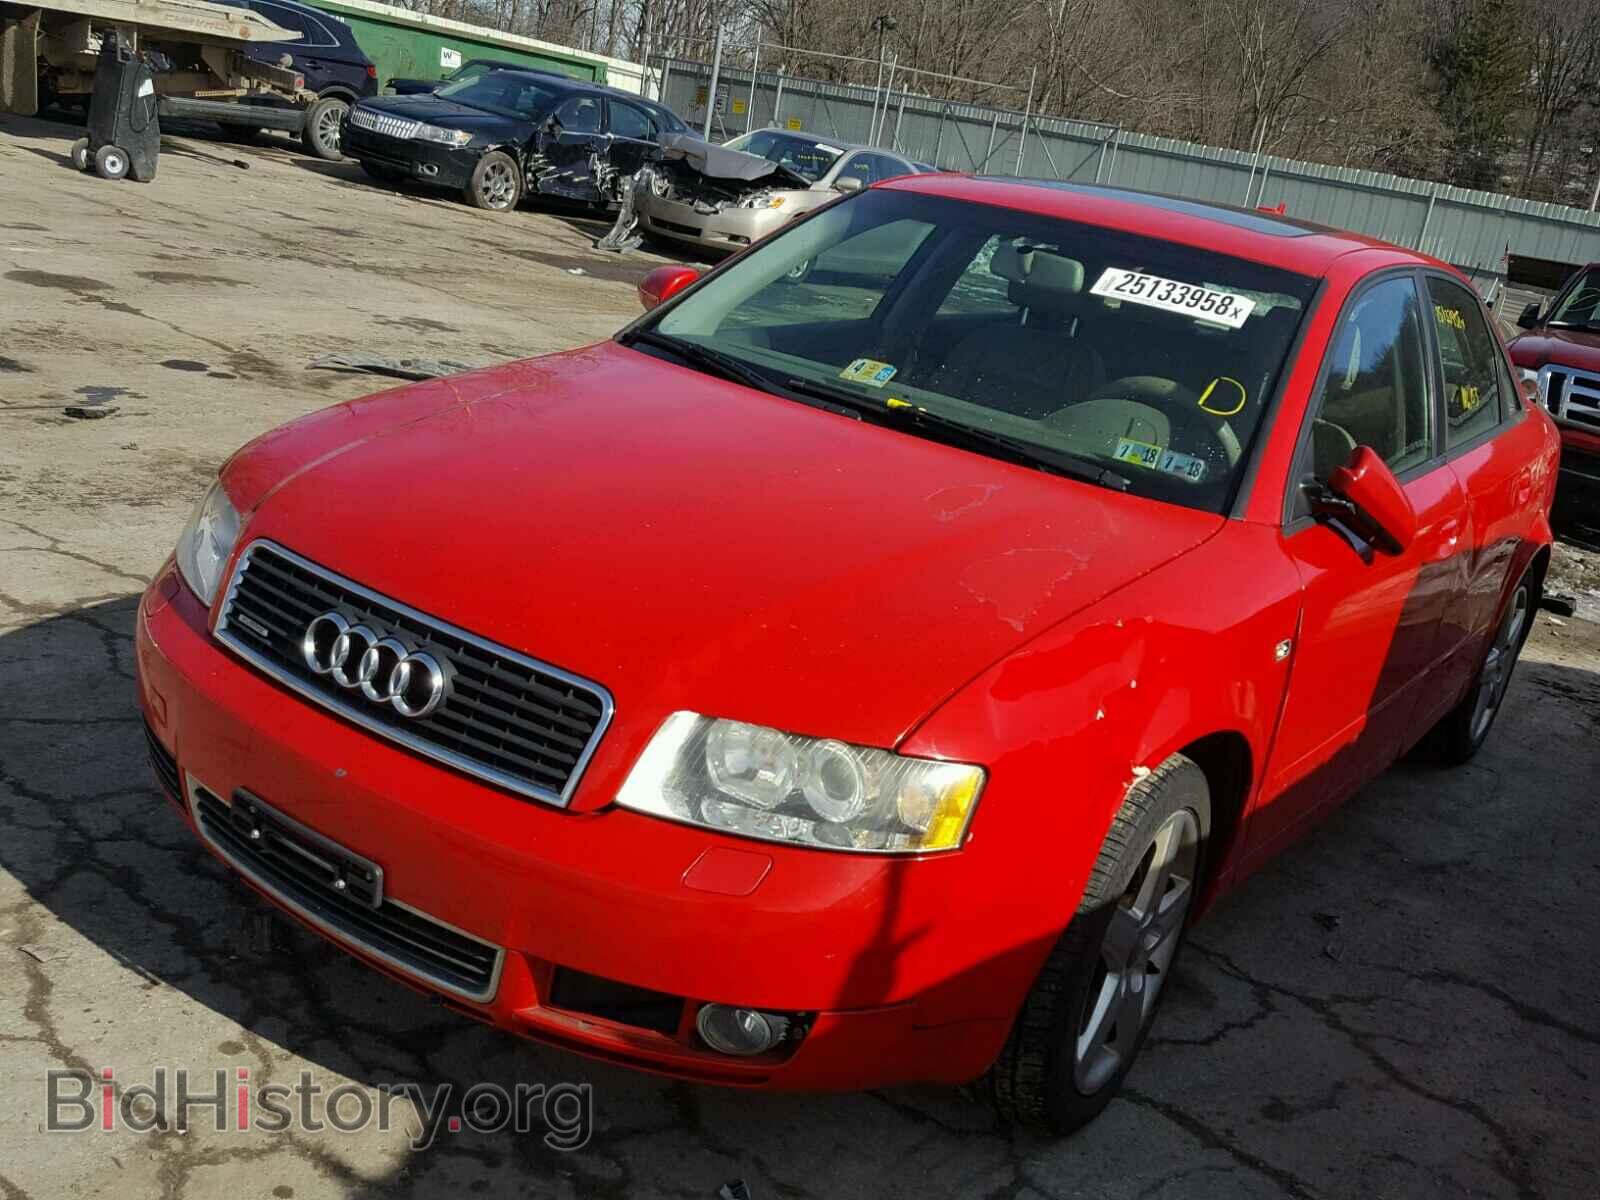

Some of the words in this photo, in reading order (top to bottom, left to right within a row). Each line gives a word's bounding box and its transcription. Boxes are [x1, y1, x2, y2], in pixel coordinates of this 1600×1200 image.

[1198, 376, 1246, 415] D
[1142, 447, 1157, 464] 18
[1186, 460, 1202, 480] 18
